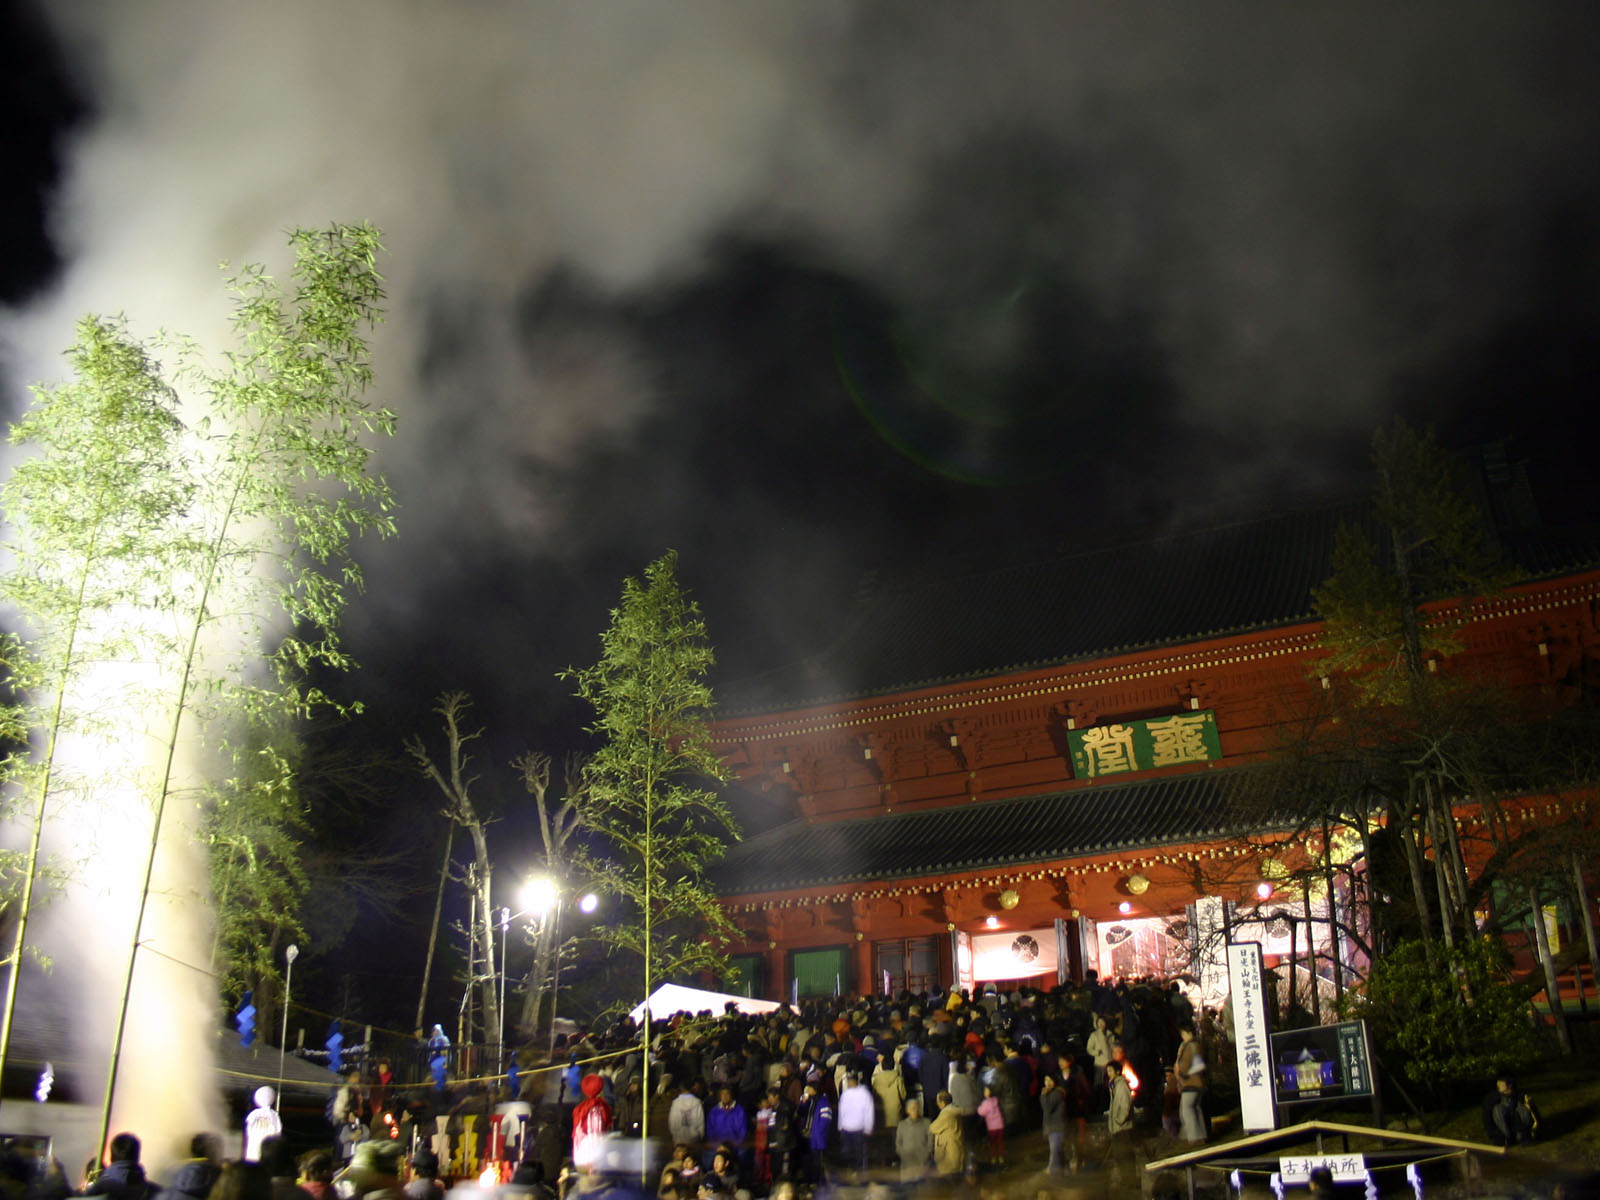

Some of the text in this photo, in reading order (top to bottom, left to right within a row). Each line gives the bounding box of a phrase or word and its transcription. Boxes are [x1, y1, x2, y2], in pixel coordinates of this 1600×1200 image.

[1244, 1034, 1263, 1088] 三佛堂
[1283, 1158, 1359, 1176] 古札納所
